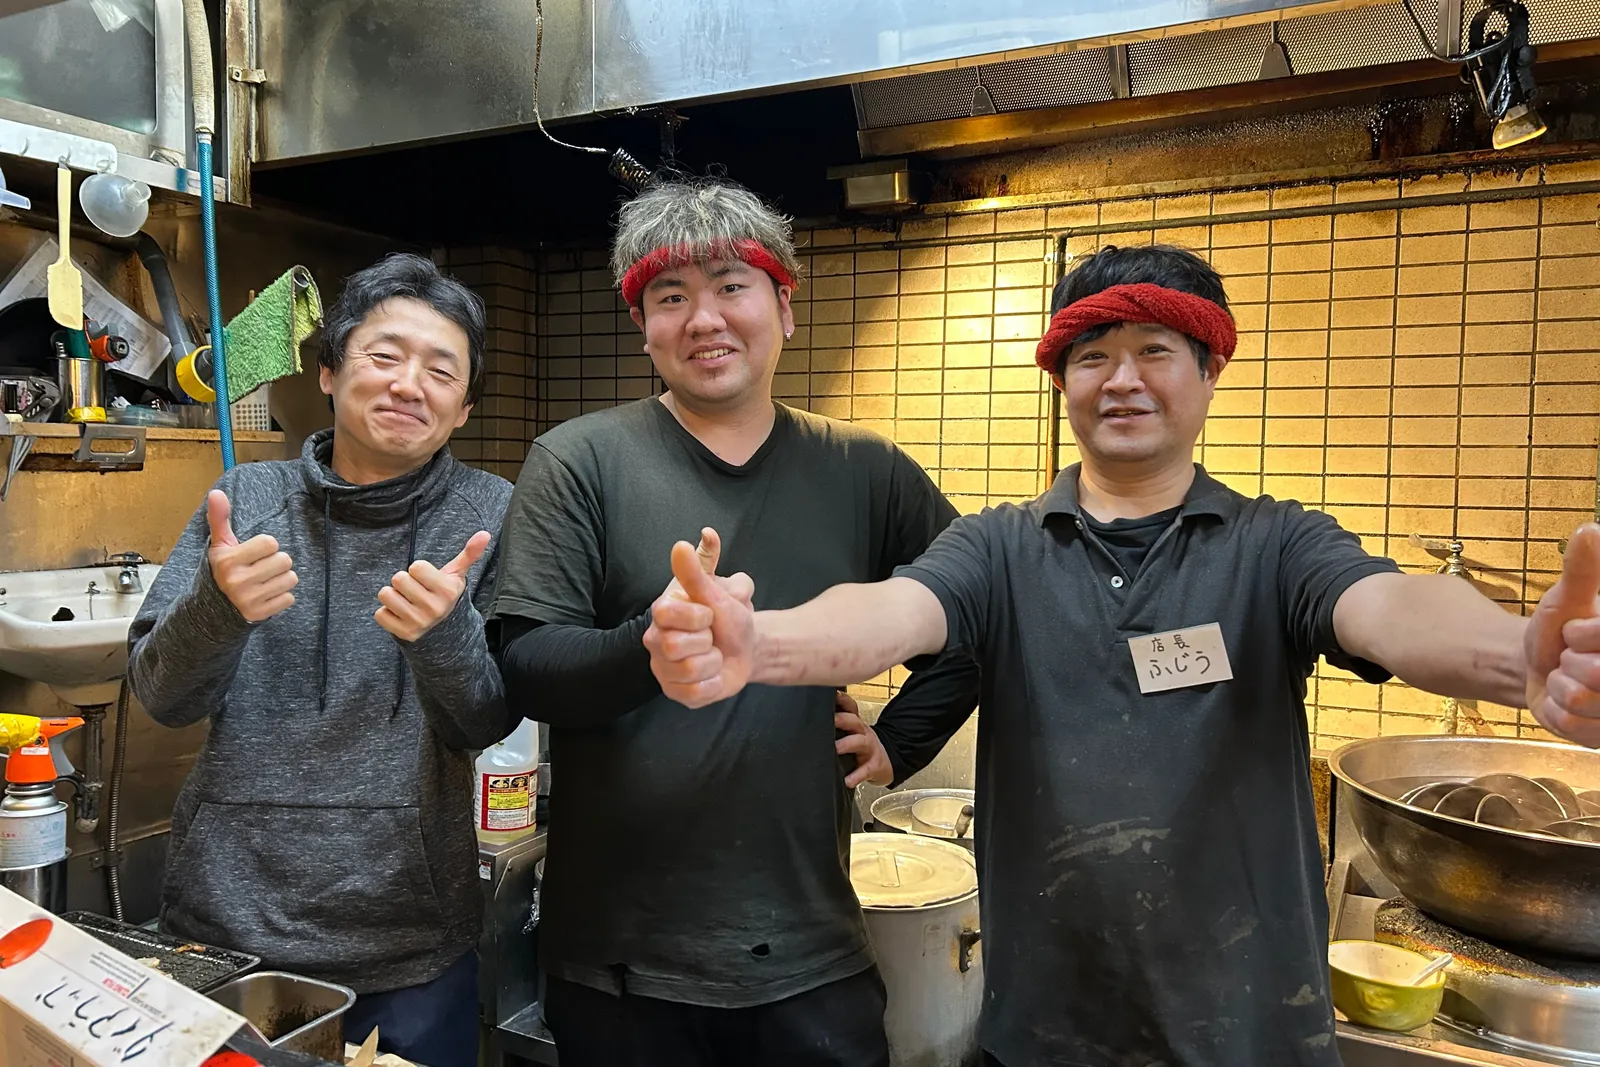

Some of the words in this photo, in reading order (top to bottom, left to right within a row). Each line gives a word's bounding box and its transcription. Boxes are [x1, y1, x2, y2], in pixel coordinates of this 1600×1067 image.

[1151, 634, 1190, 652] 店長
[1149, 651, 1210, 679] ふじう
